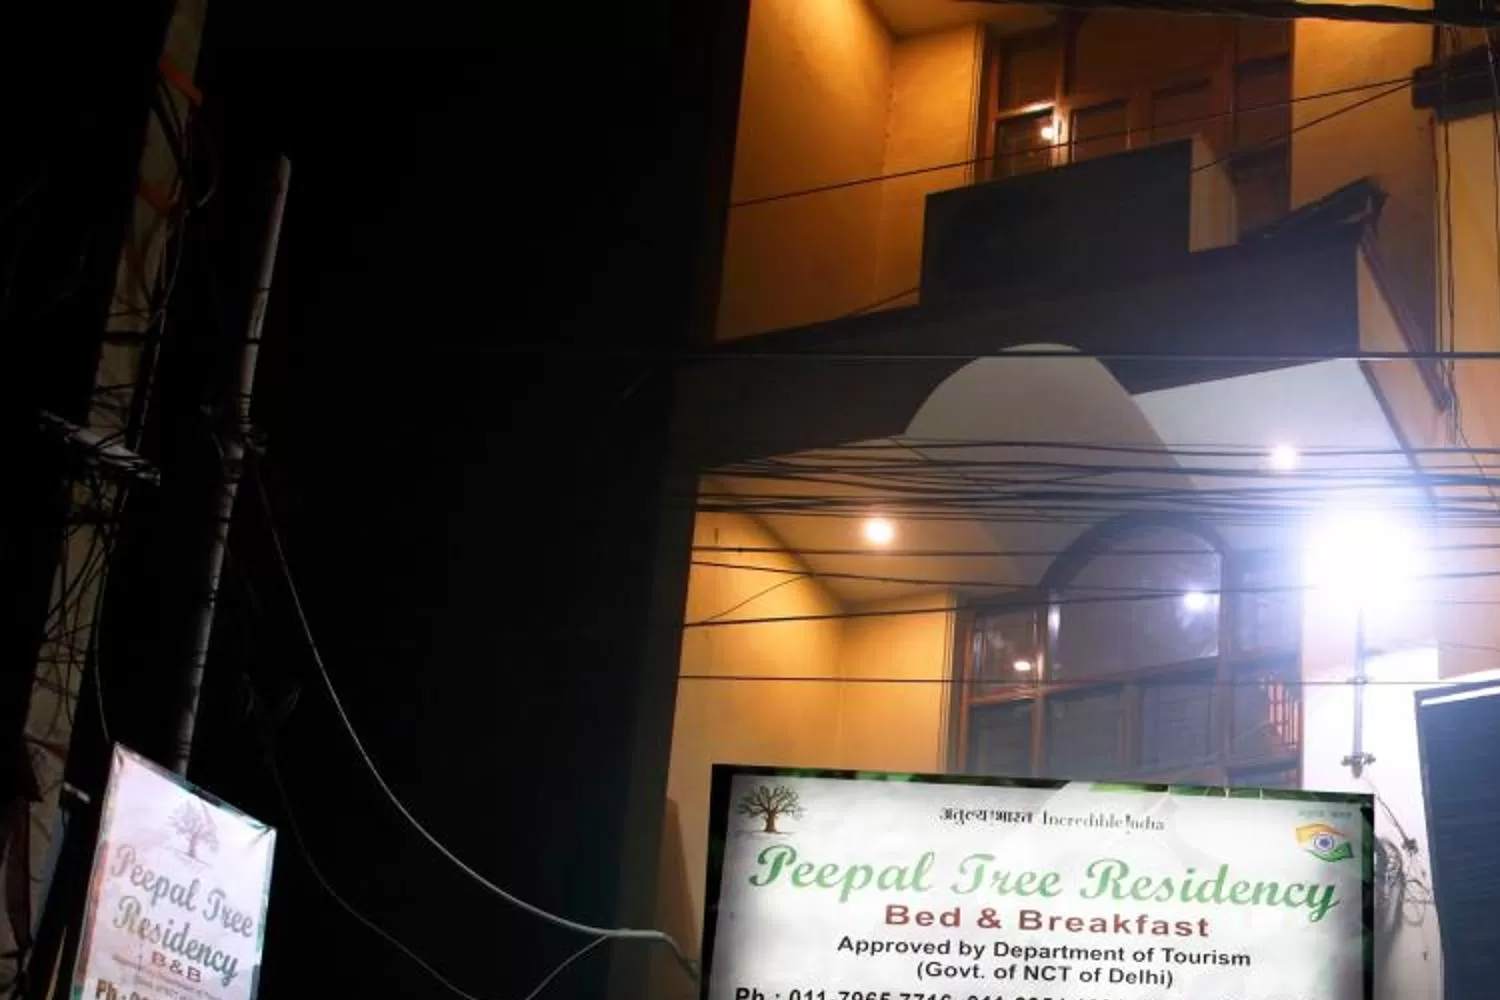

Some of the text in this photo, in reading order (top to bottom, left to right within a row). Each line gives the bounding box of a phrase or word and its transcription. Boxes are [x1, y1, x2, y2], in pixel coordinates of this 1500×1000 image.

[111, 843, 253, 938] Peepal Tree
[748, 844, 1340, 923] Peepal Tree Residency
[112, 895, 239, 987] Residency
[884, 904, 1212, 938] Bed & Breakfast
[837, 935, 1251, 967] Approved by Department of Tourism
[916, 960, 1174, 989] (Govt. of NCT of Delhi)
